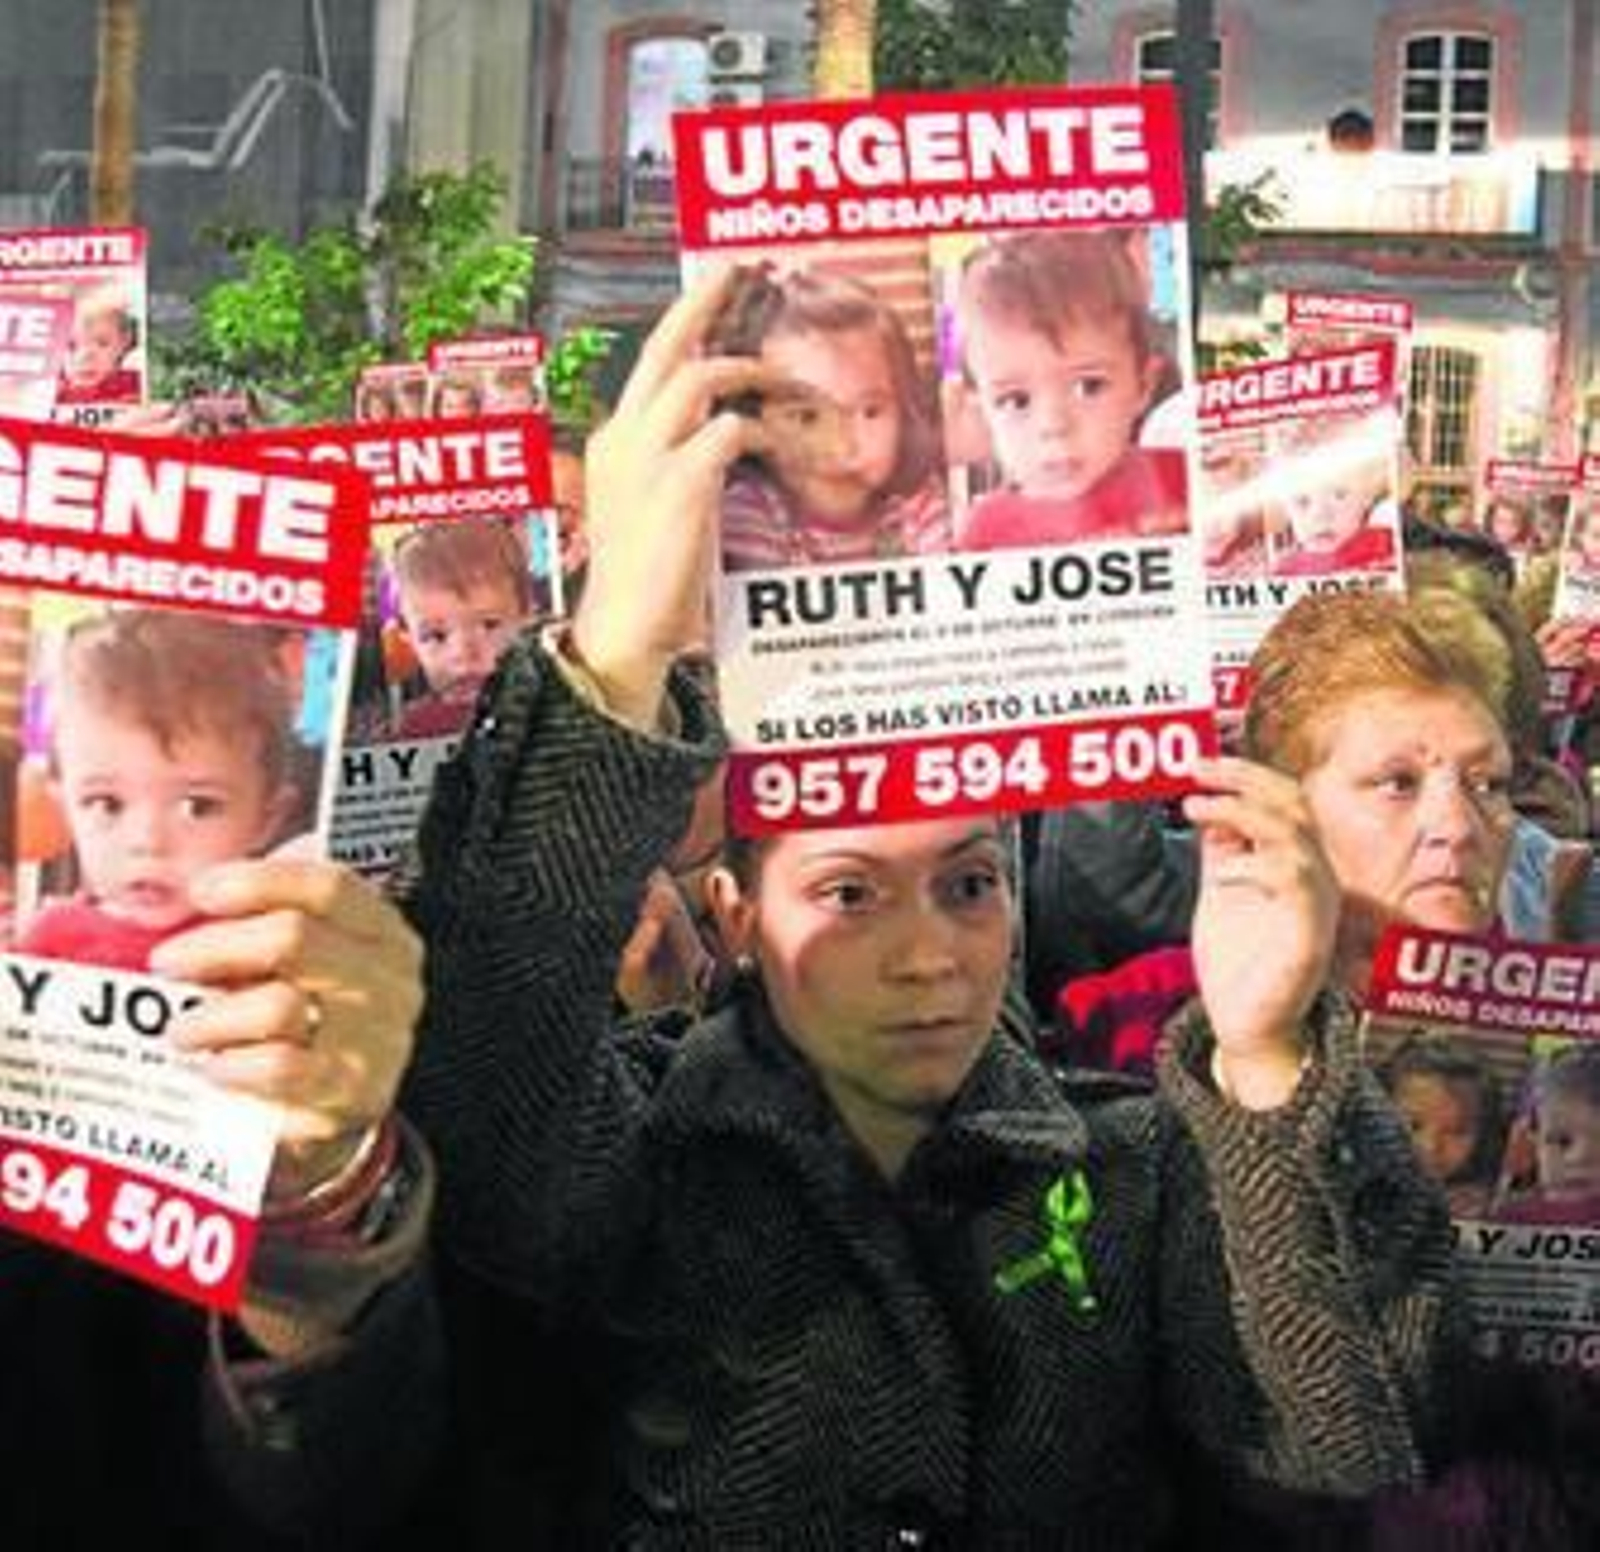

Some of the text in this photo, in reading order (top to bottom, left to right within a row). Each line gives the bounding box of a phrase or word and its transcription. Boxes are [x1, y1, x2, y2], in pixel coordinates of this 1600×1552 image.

[702, 105, 1149, 197] URGENTE
[707, 186, 1154, 241] NIÑOS DESAPARECIDOS
[1203, 351, 1381, 410] RGENTE
[258, 430, 526, 487] ENTE
[746, 548, 1174, 628] RUTH Y JOSE
[1267, 582, 1289, 604] Y
[757, 719, 786, 743] SI
[795, 713, 858, 741] LOS
[866, 705, 930, 736] HAS
[936, 697, 1023, 728] VISTO
[1033, 684, 1134, 717] LLAMA
[389, 747, 419, 780] Y
[750, 723, 1200, 822] 957 594 500
[7, 964, 205, 1037] Y JO
[1386, 989, 1471, 1021] NIÑOS
[88, 1124, 190, 1171] LLAMA
[0, 1151, 235, 1286] 94 500
[1478, 1228, 1506, 1256] Y
